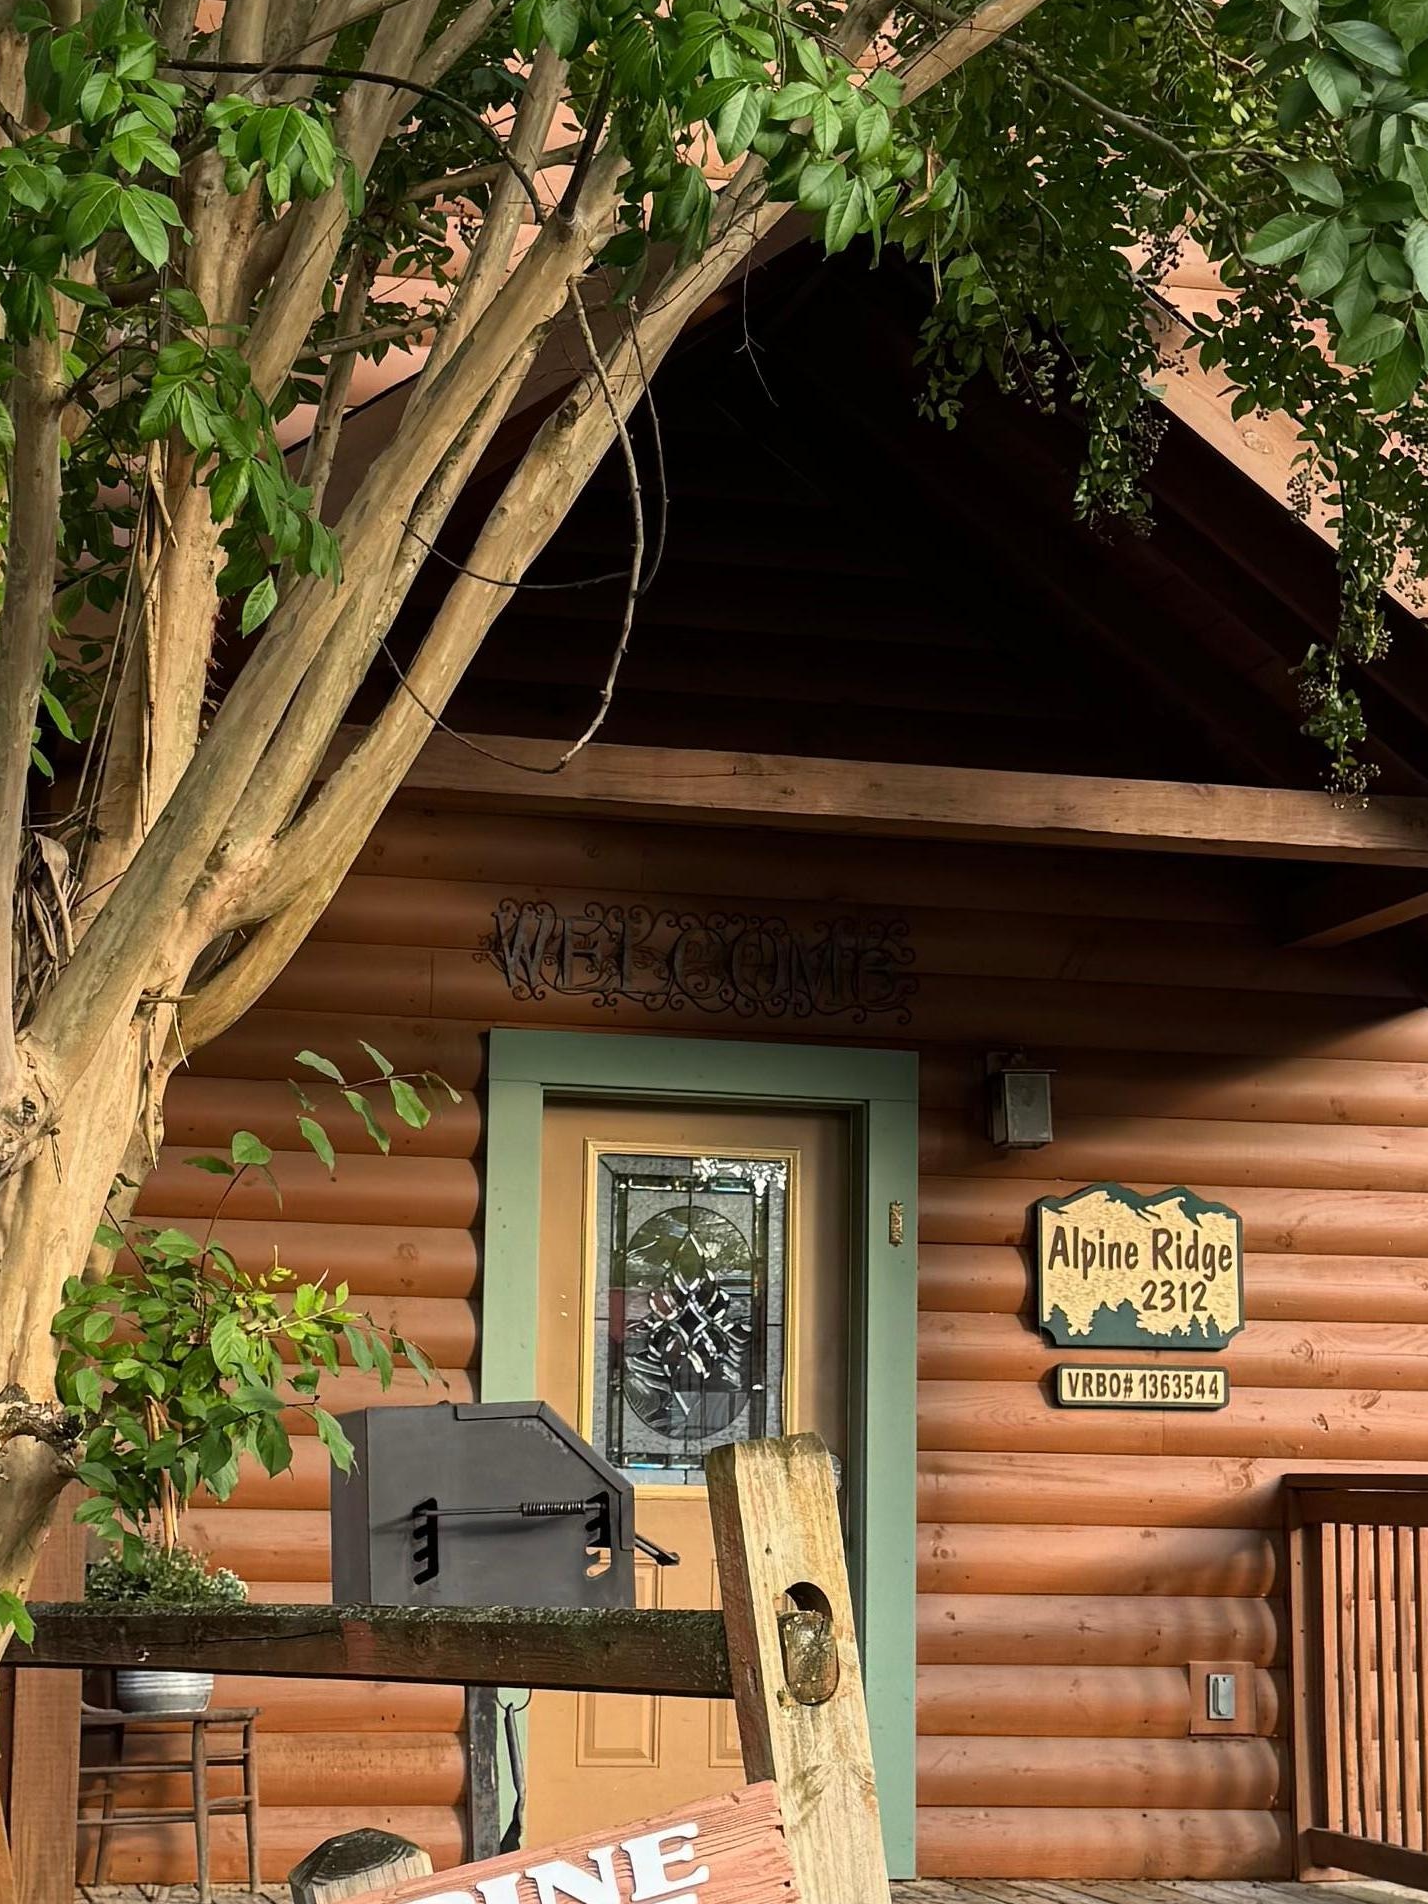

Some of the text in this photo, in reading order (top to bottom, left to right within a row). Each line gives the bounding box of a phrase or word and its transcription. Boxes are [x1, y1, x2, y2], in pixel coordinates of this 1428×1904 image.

[486, 900, 913, 1016] WELCOME
[1048, 1226, 1233, 1282] Alpine Ridge
[1141, 1280, 1208, 1313] 2312
[1068, 1372, 1219, 1400] VRBO# 1363544
